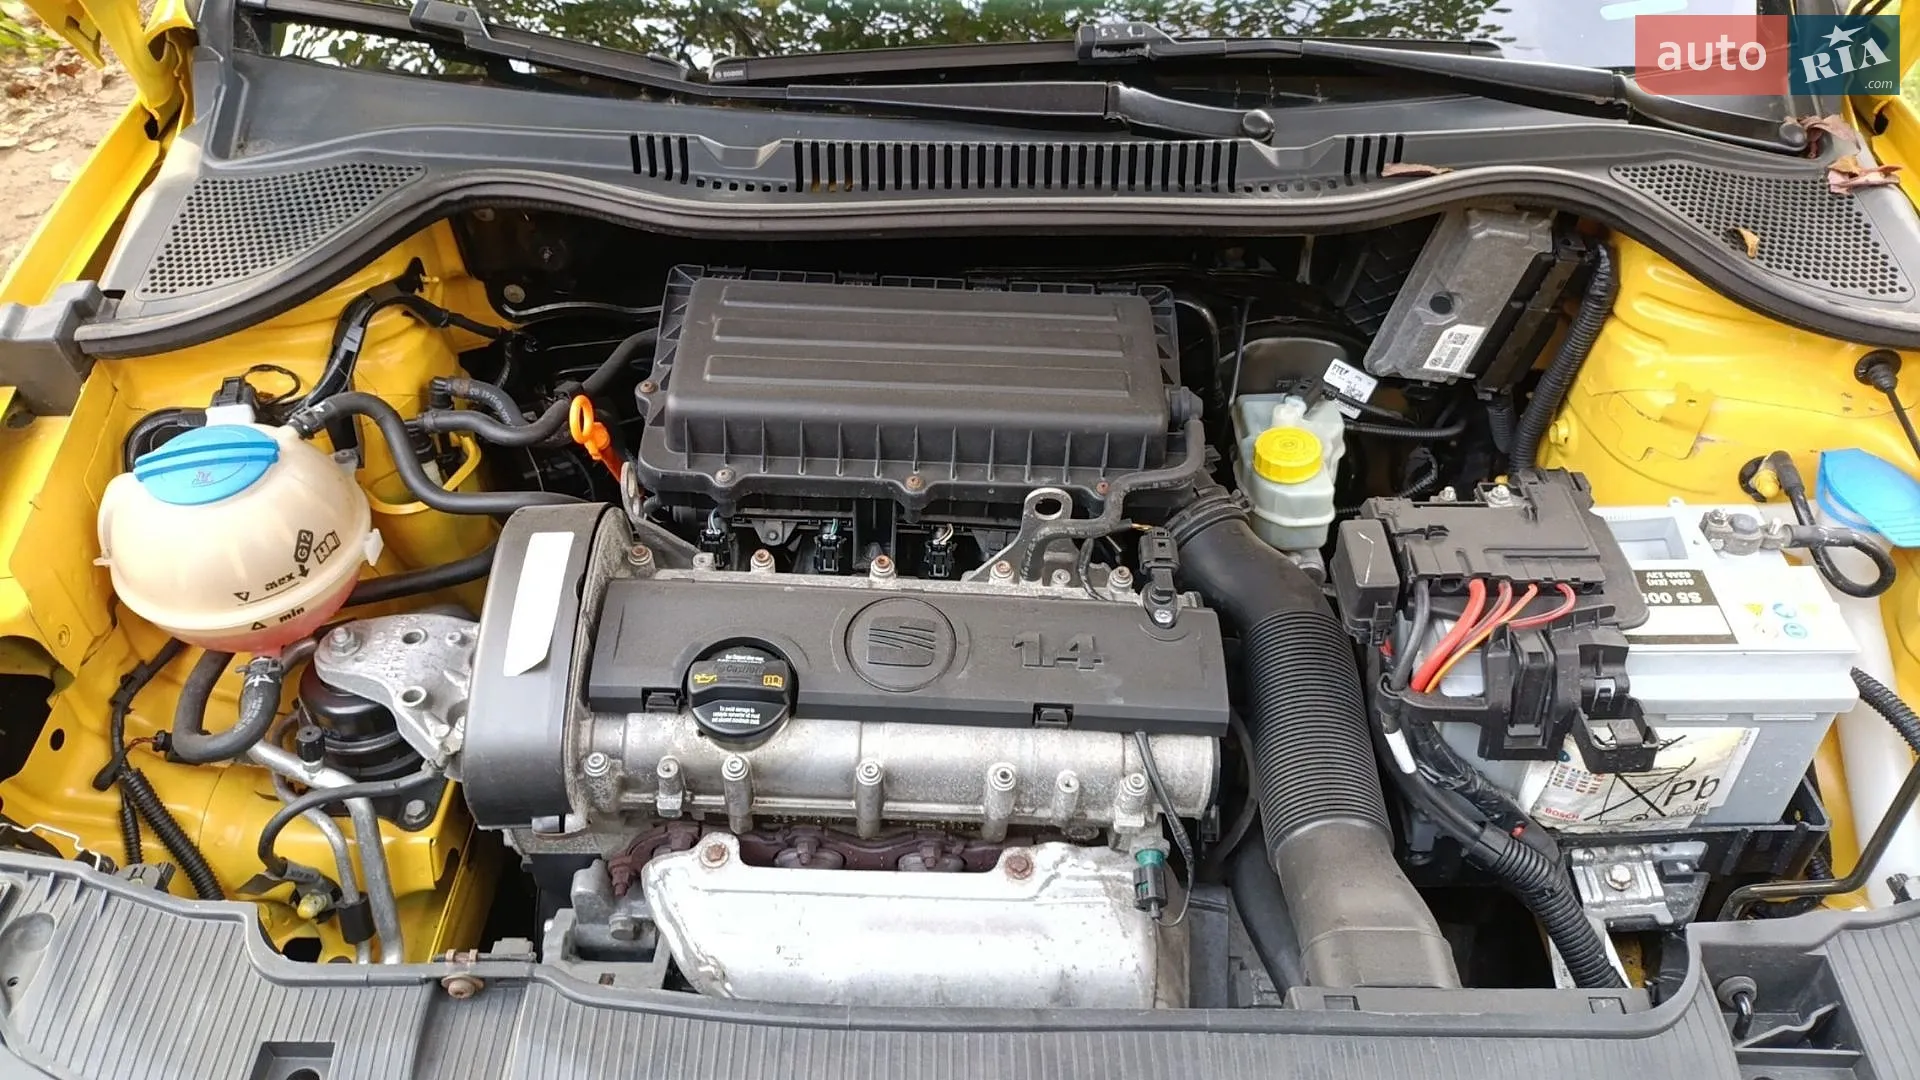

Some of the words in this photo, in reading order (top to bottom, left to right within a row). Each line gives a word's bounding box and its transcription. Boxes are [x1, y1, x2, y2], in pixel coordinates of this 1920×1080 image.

[296, 531, 312, 561] G12
[265, 572, 296, 592] max
[279, 607, 305, 622] min
[1011, 632, 1104, 672] 1.4
[1663, 775, 1721, 807] Pb
[1543, 806, 1580, 820] BOSCH
